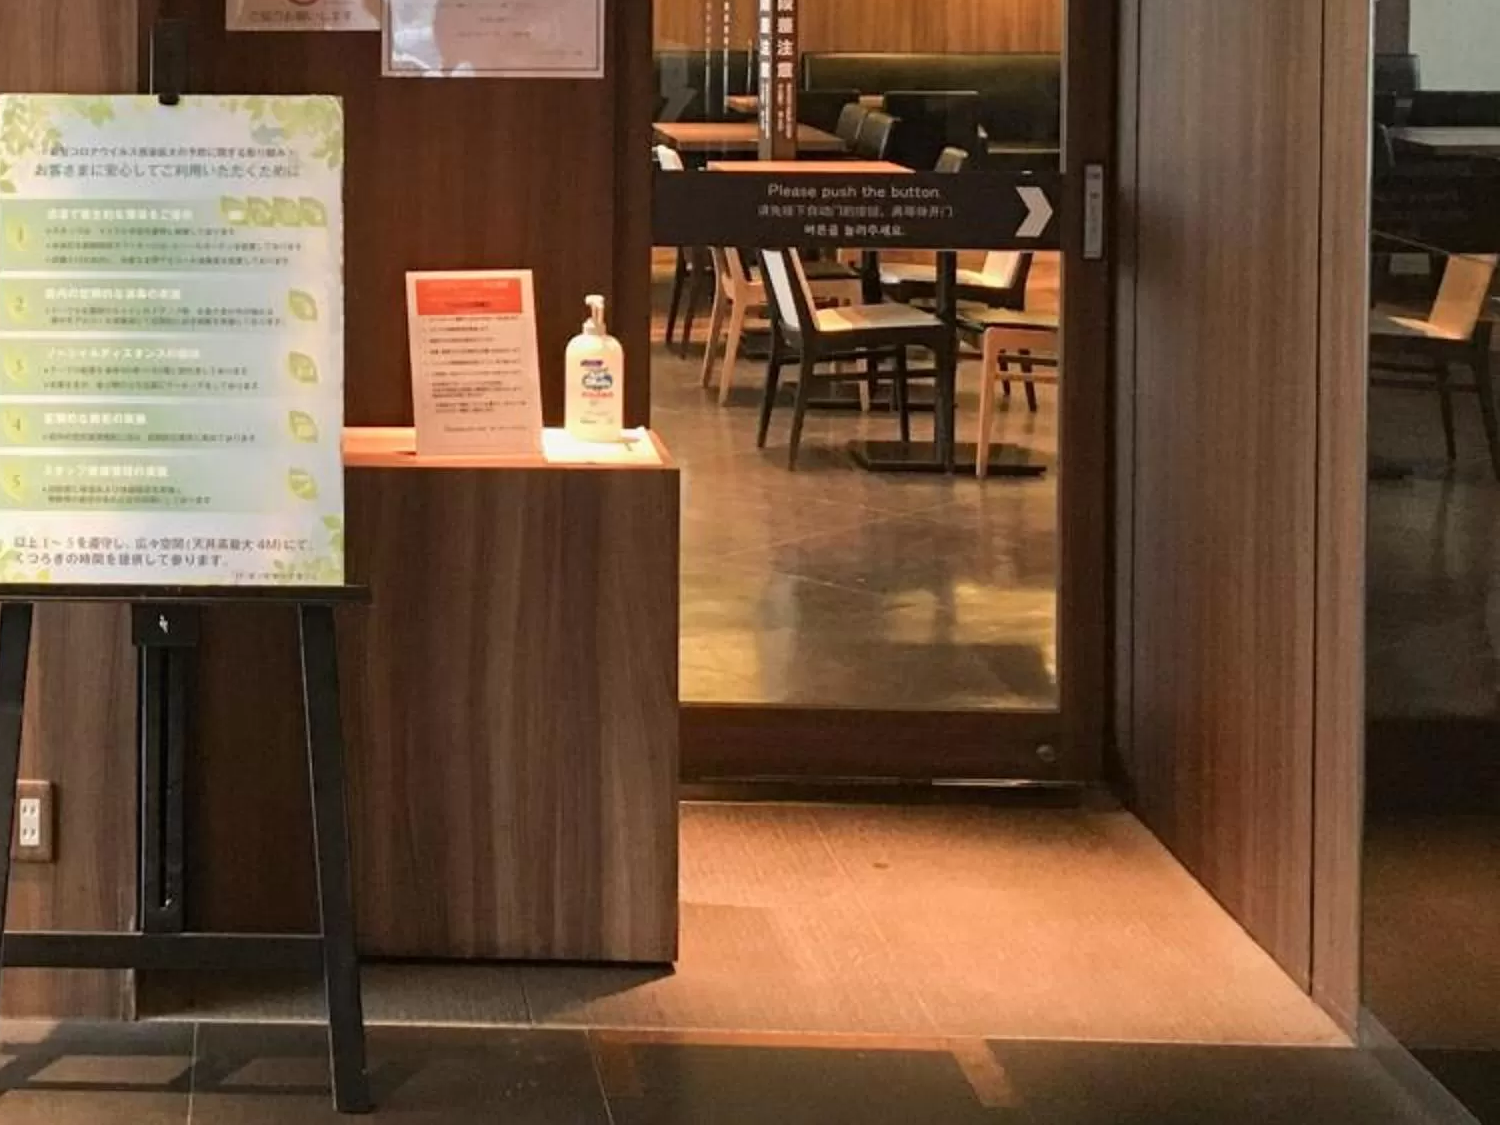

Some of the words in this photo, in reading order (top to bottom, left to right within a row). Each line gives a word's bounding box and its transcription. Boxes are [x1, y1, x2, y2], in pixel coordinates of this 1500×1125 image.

[766, 182, 817, 198] Please
[821, 185, 857, 199] push
[861, 184, 886, 198] the
